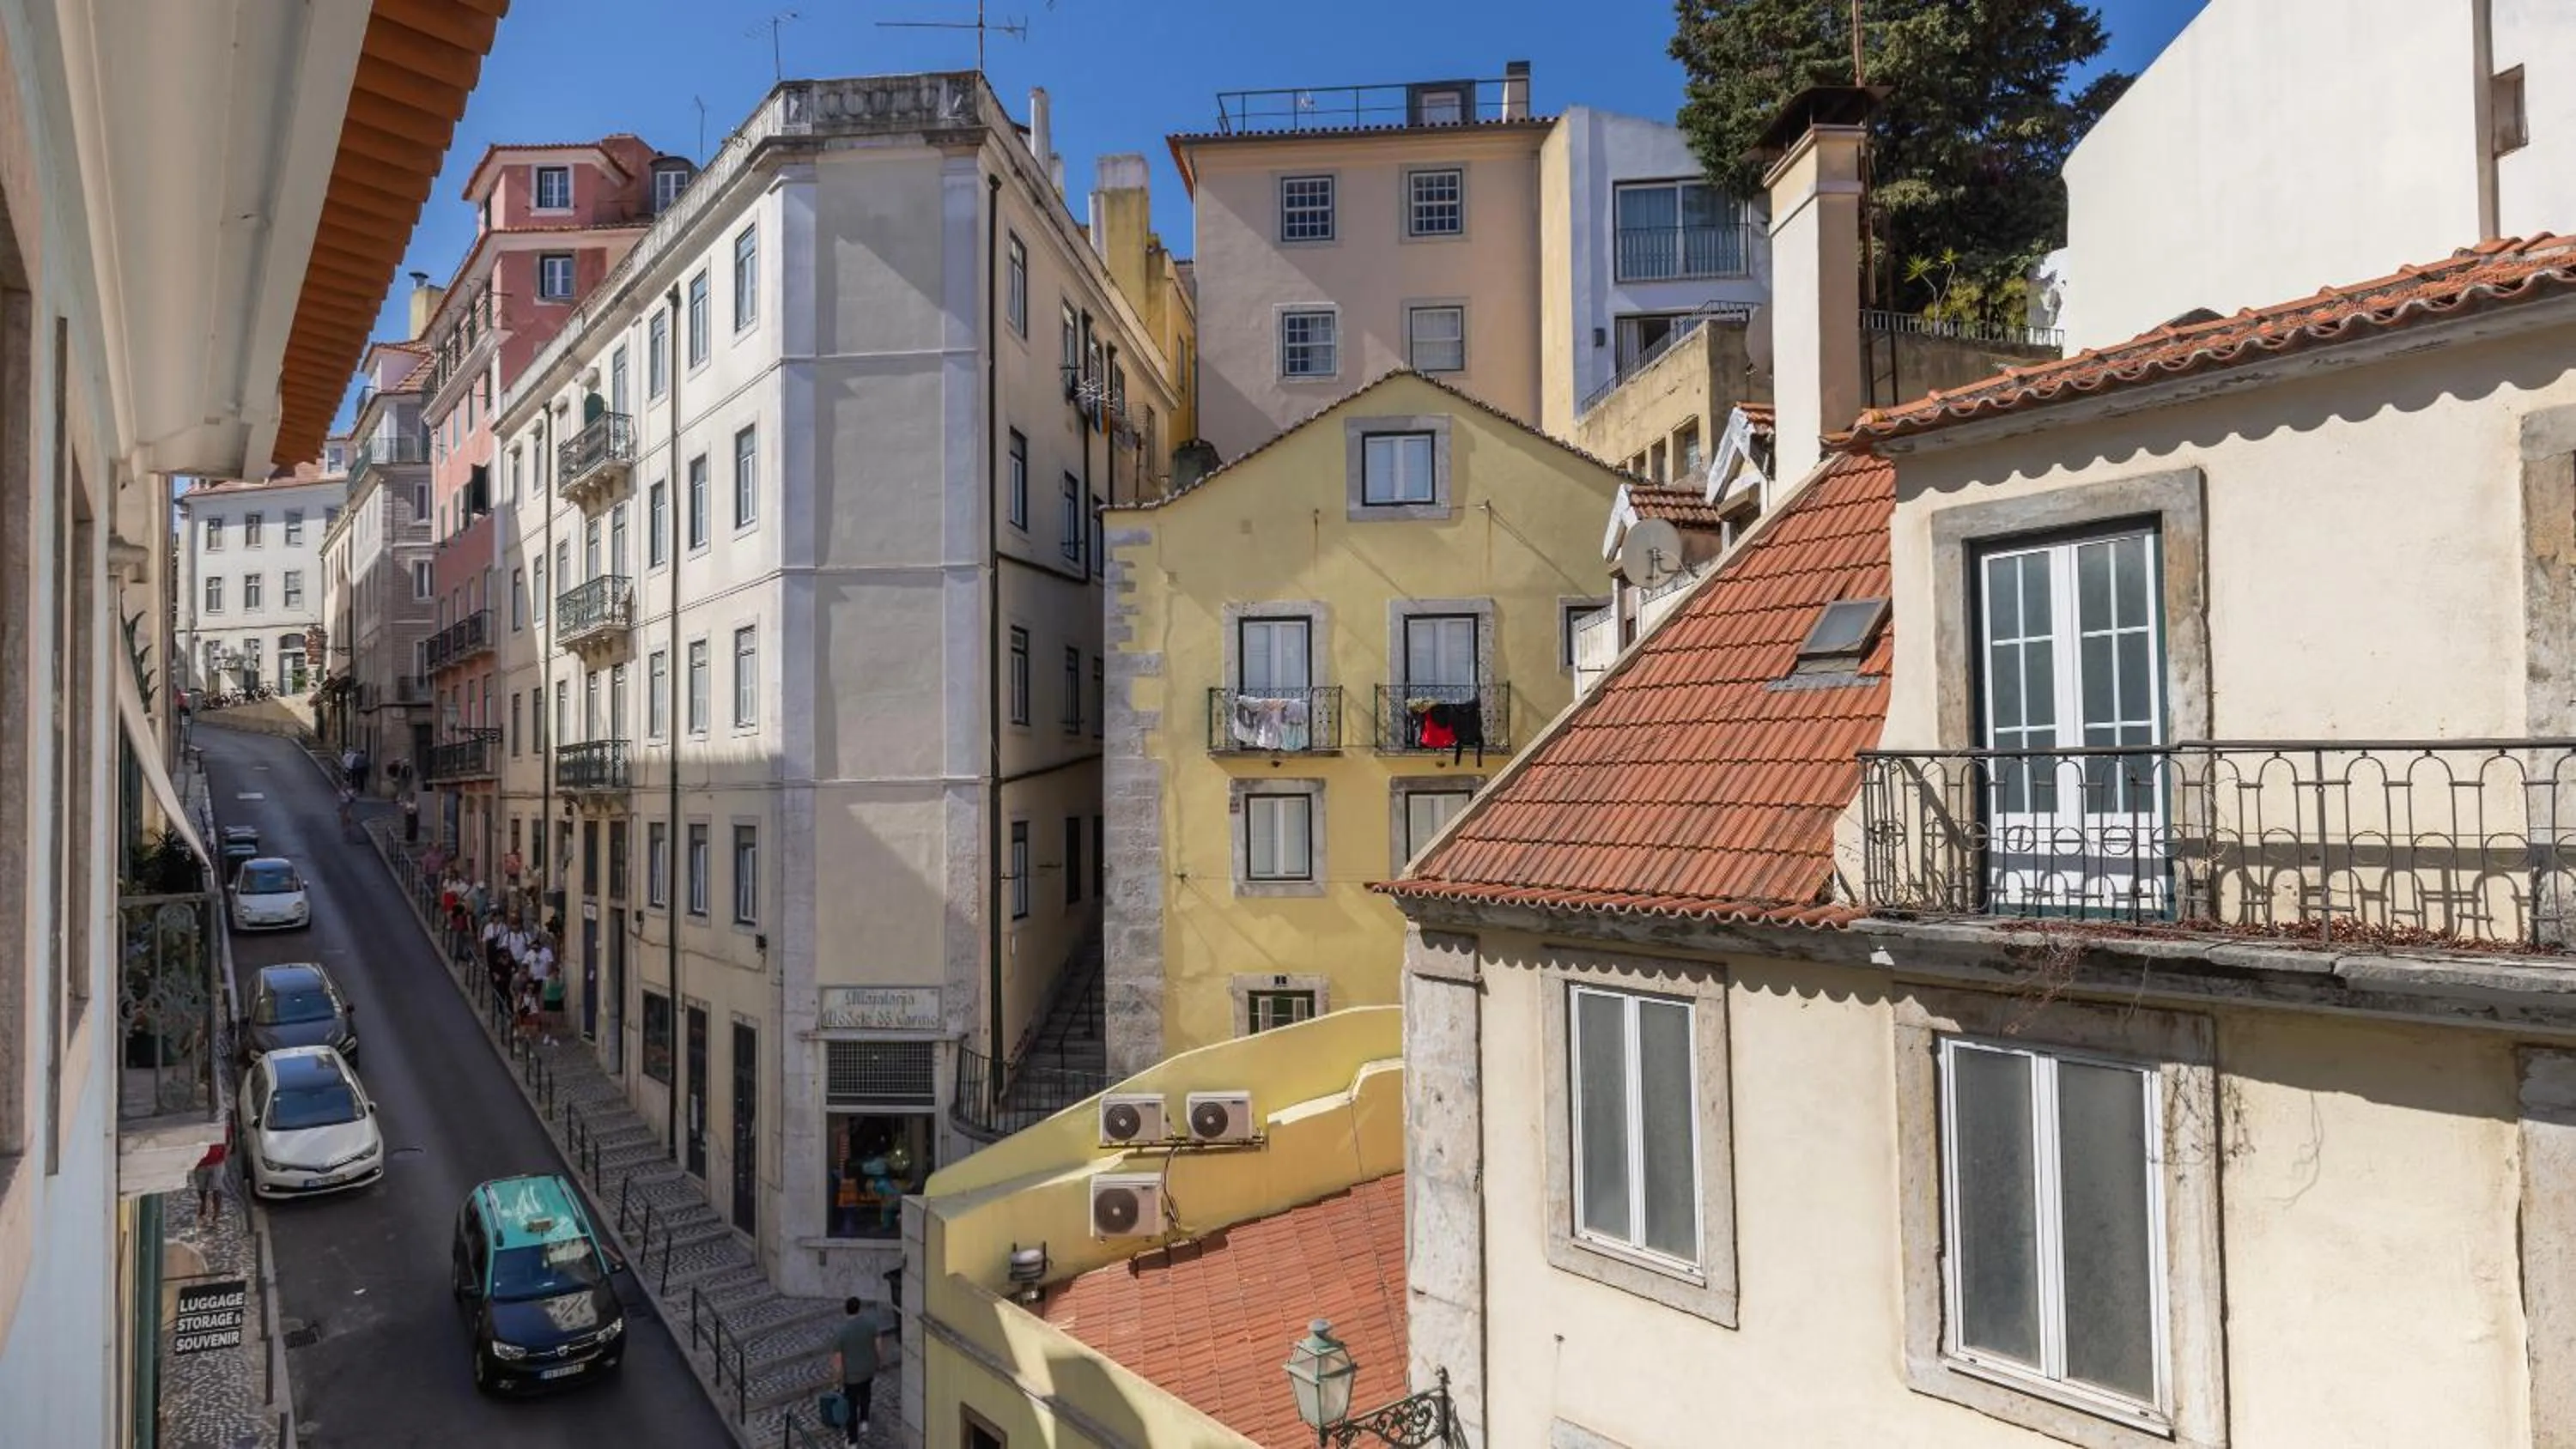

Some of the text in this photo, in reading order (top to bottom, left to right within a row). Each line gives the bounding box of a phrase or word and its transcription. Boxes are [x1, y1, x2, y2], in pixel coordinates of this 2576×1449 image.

[179, 1292, 244, 1313] LUGGAGE
[177, 1312, 234, 1332] STORAGE
[175, 1331, 240, 1353] SOUVENIR
